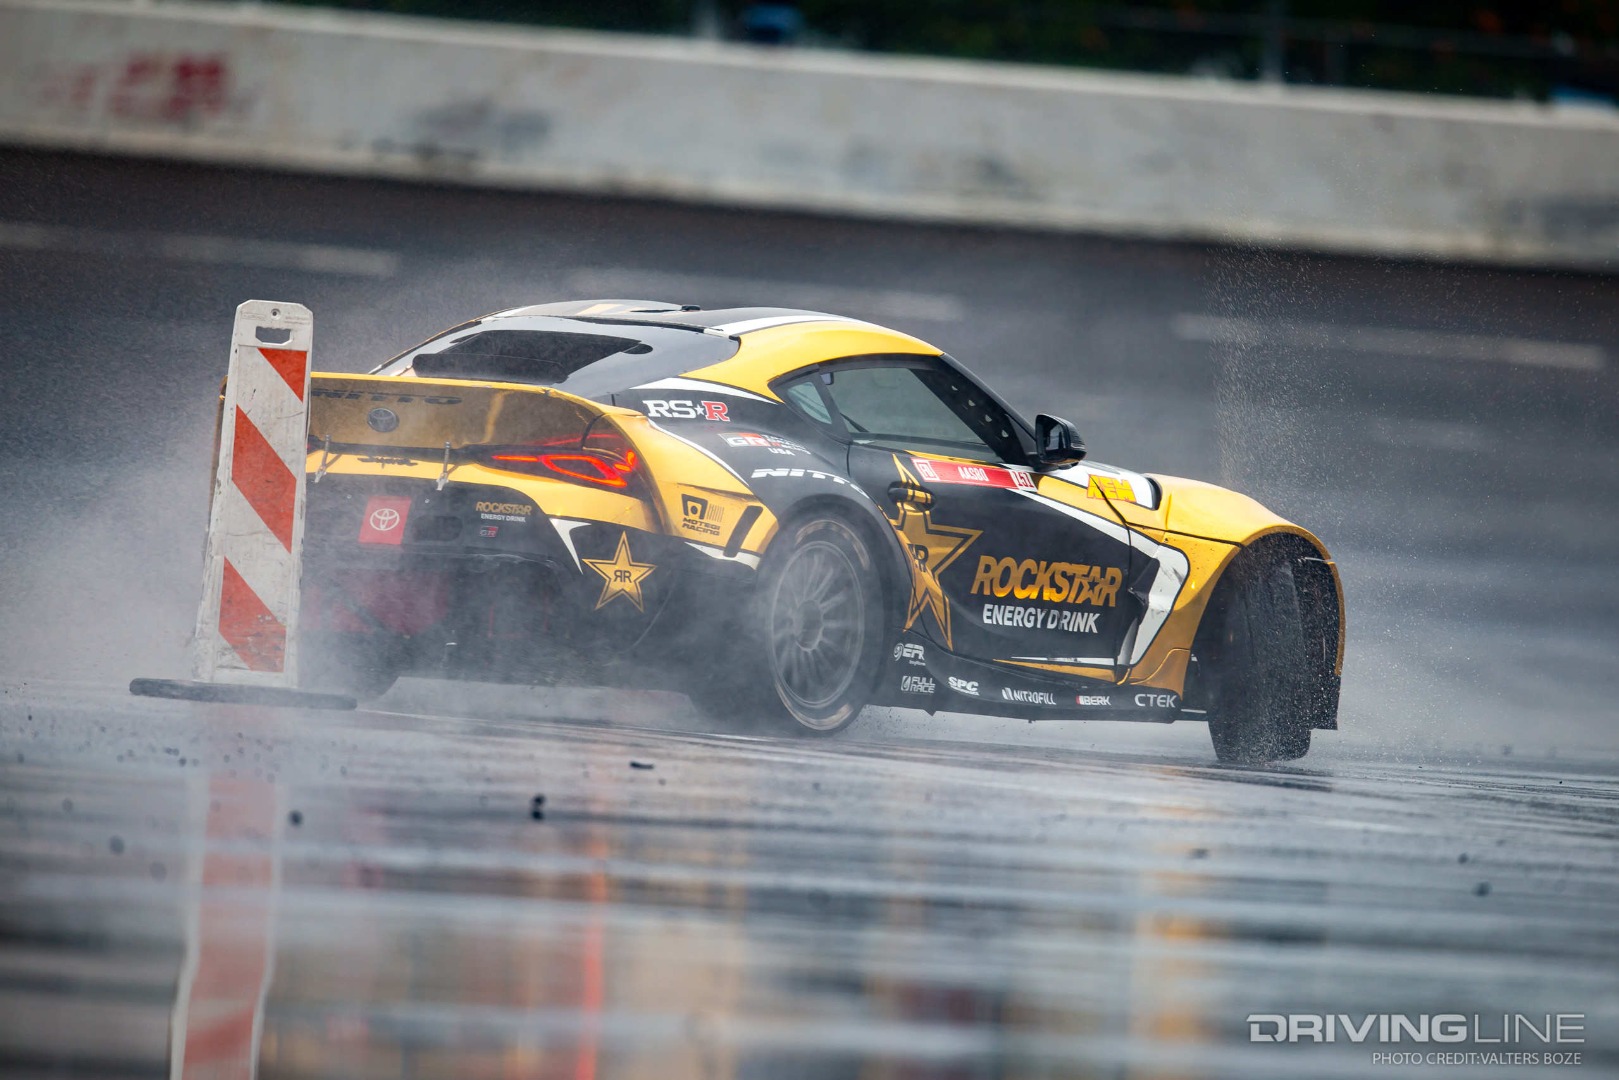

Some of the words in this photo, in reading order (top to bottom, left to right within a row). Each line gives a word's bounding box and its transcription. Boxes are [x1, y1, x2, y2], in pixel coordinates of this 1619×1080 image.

[957, 466, 990, 482] AASBO
[1012, 471, 1035, 488] 151
[1087, 474, 1137, 503] AEM
[475, 501, 532, 515] ROCKSTAR
[481, 513, 505, 521] ENERGY
[682, 518, 720, 530] MOTEGI
[682, 523, 720, 536] RACING
[970, 555, 1123, 607] ROCKSTAR
[983, 603, 1048, 628] ENERGY
[1046, 610, 1101, 634] DRINK
[909, 683, 936, 694] RACE
[910, 676, 936, 686] FULL
[948, 676, 979, 692] SPC
[1013, 690, 1057, 705] NITROFILL
[1084, 695, 1111, 706] BERK
[1134, 693, 1177, 708] CTEK
